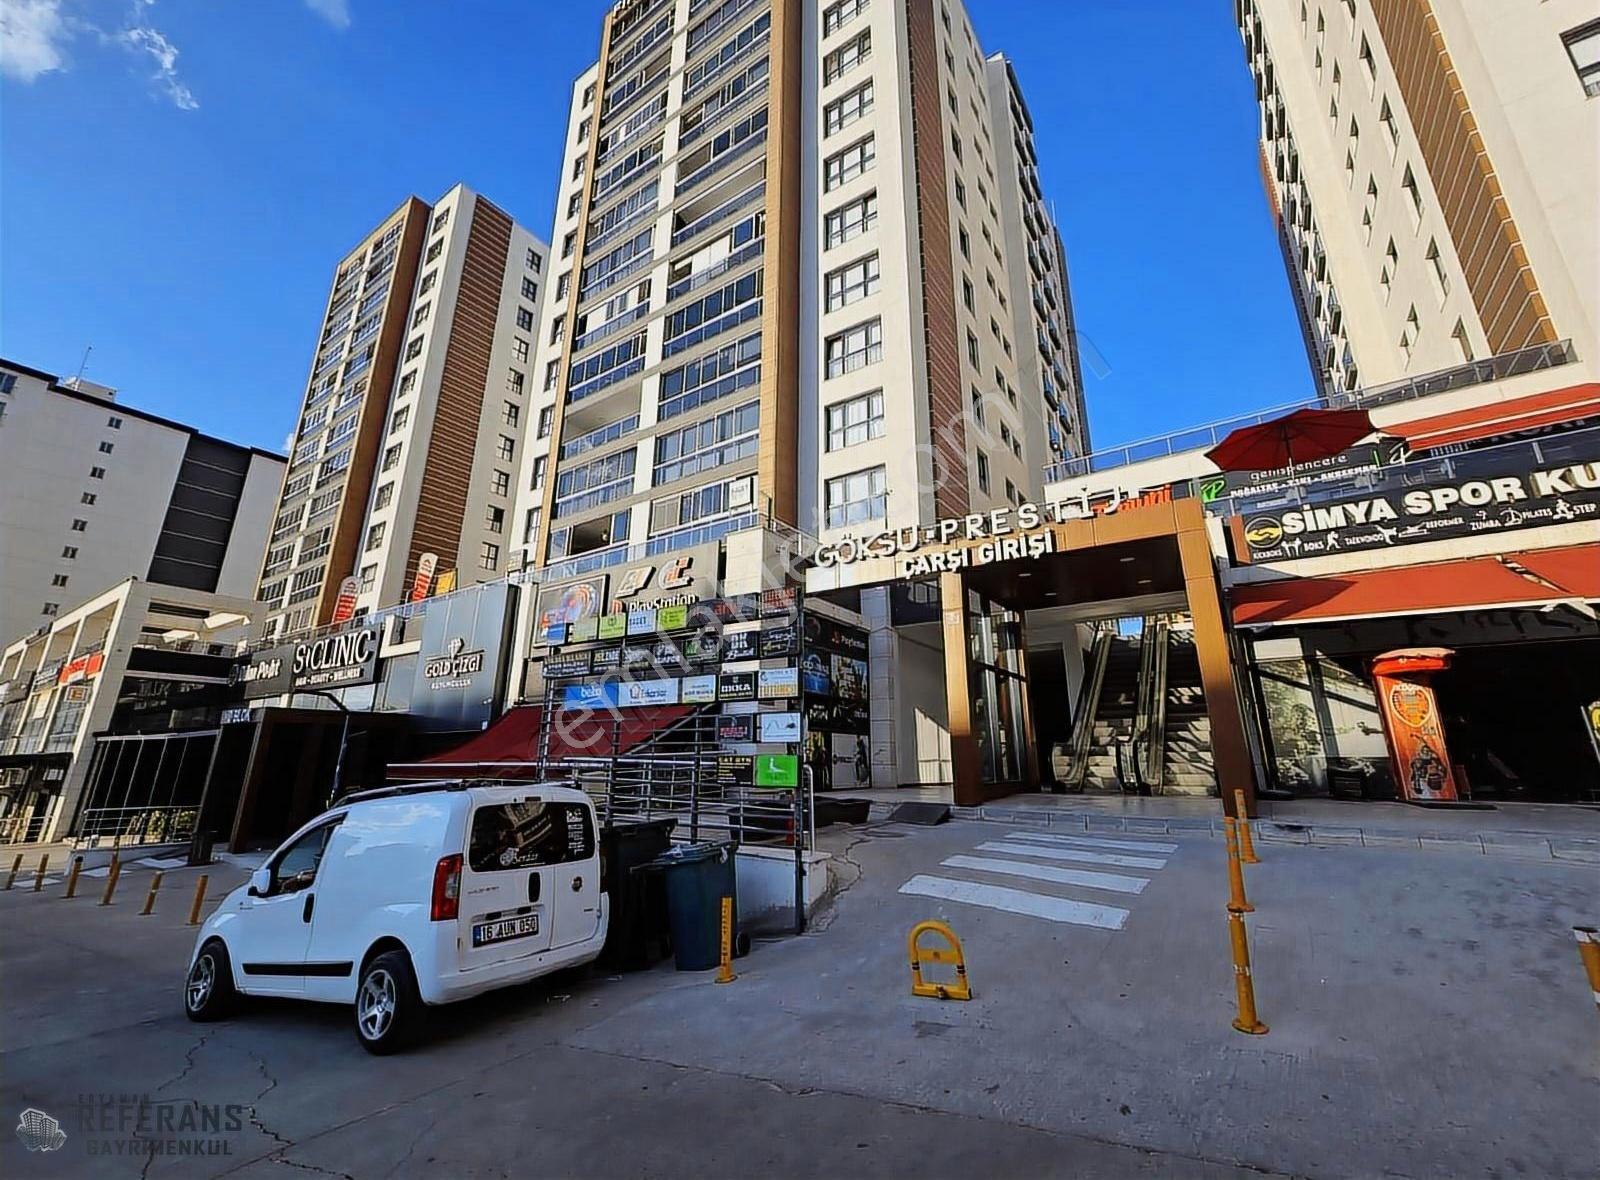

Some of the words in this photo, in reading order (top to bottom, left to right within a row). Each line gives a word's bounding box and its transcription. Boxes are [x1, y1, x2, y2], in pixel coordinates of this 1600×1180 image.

[1281, 498, 1398, 535] SİMYA
[1403, 477, 1528, 515] SPOR
[1469, 520, 1501, 531] ZUMBA
[1573, 503, 1597, 515] STEP
[814, 523, 921, 568] GÖKSU
[901, 551, 970, 579] ÇARŞI
[978, 527, 1054, 564] GİRİŞİ
[425, 661, 451, 678] GOLD
[482, 925, 493, 940] 16
